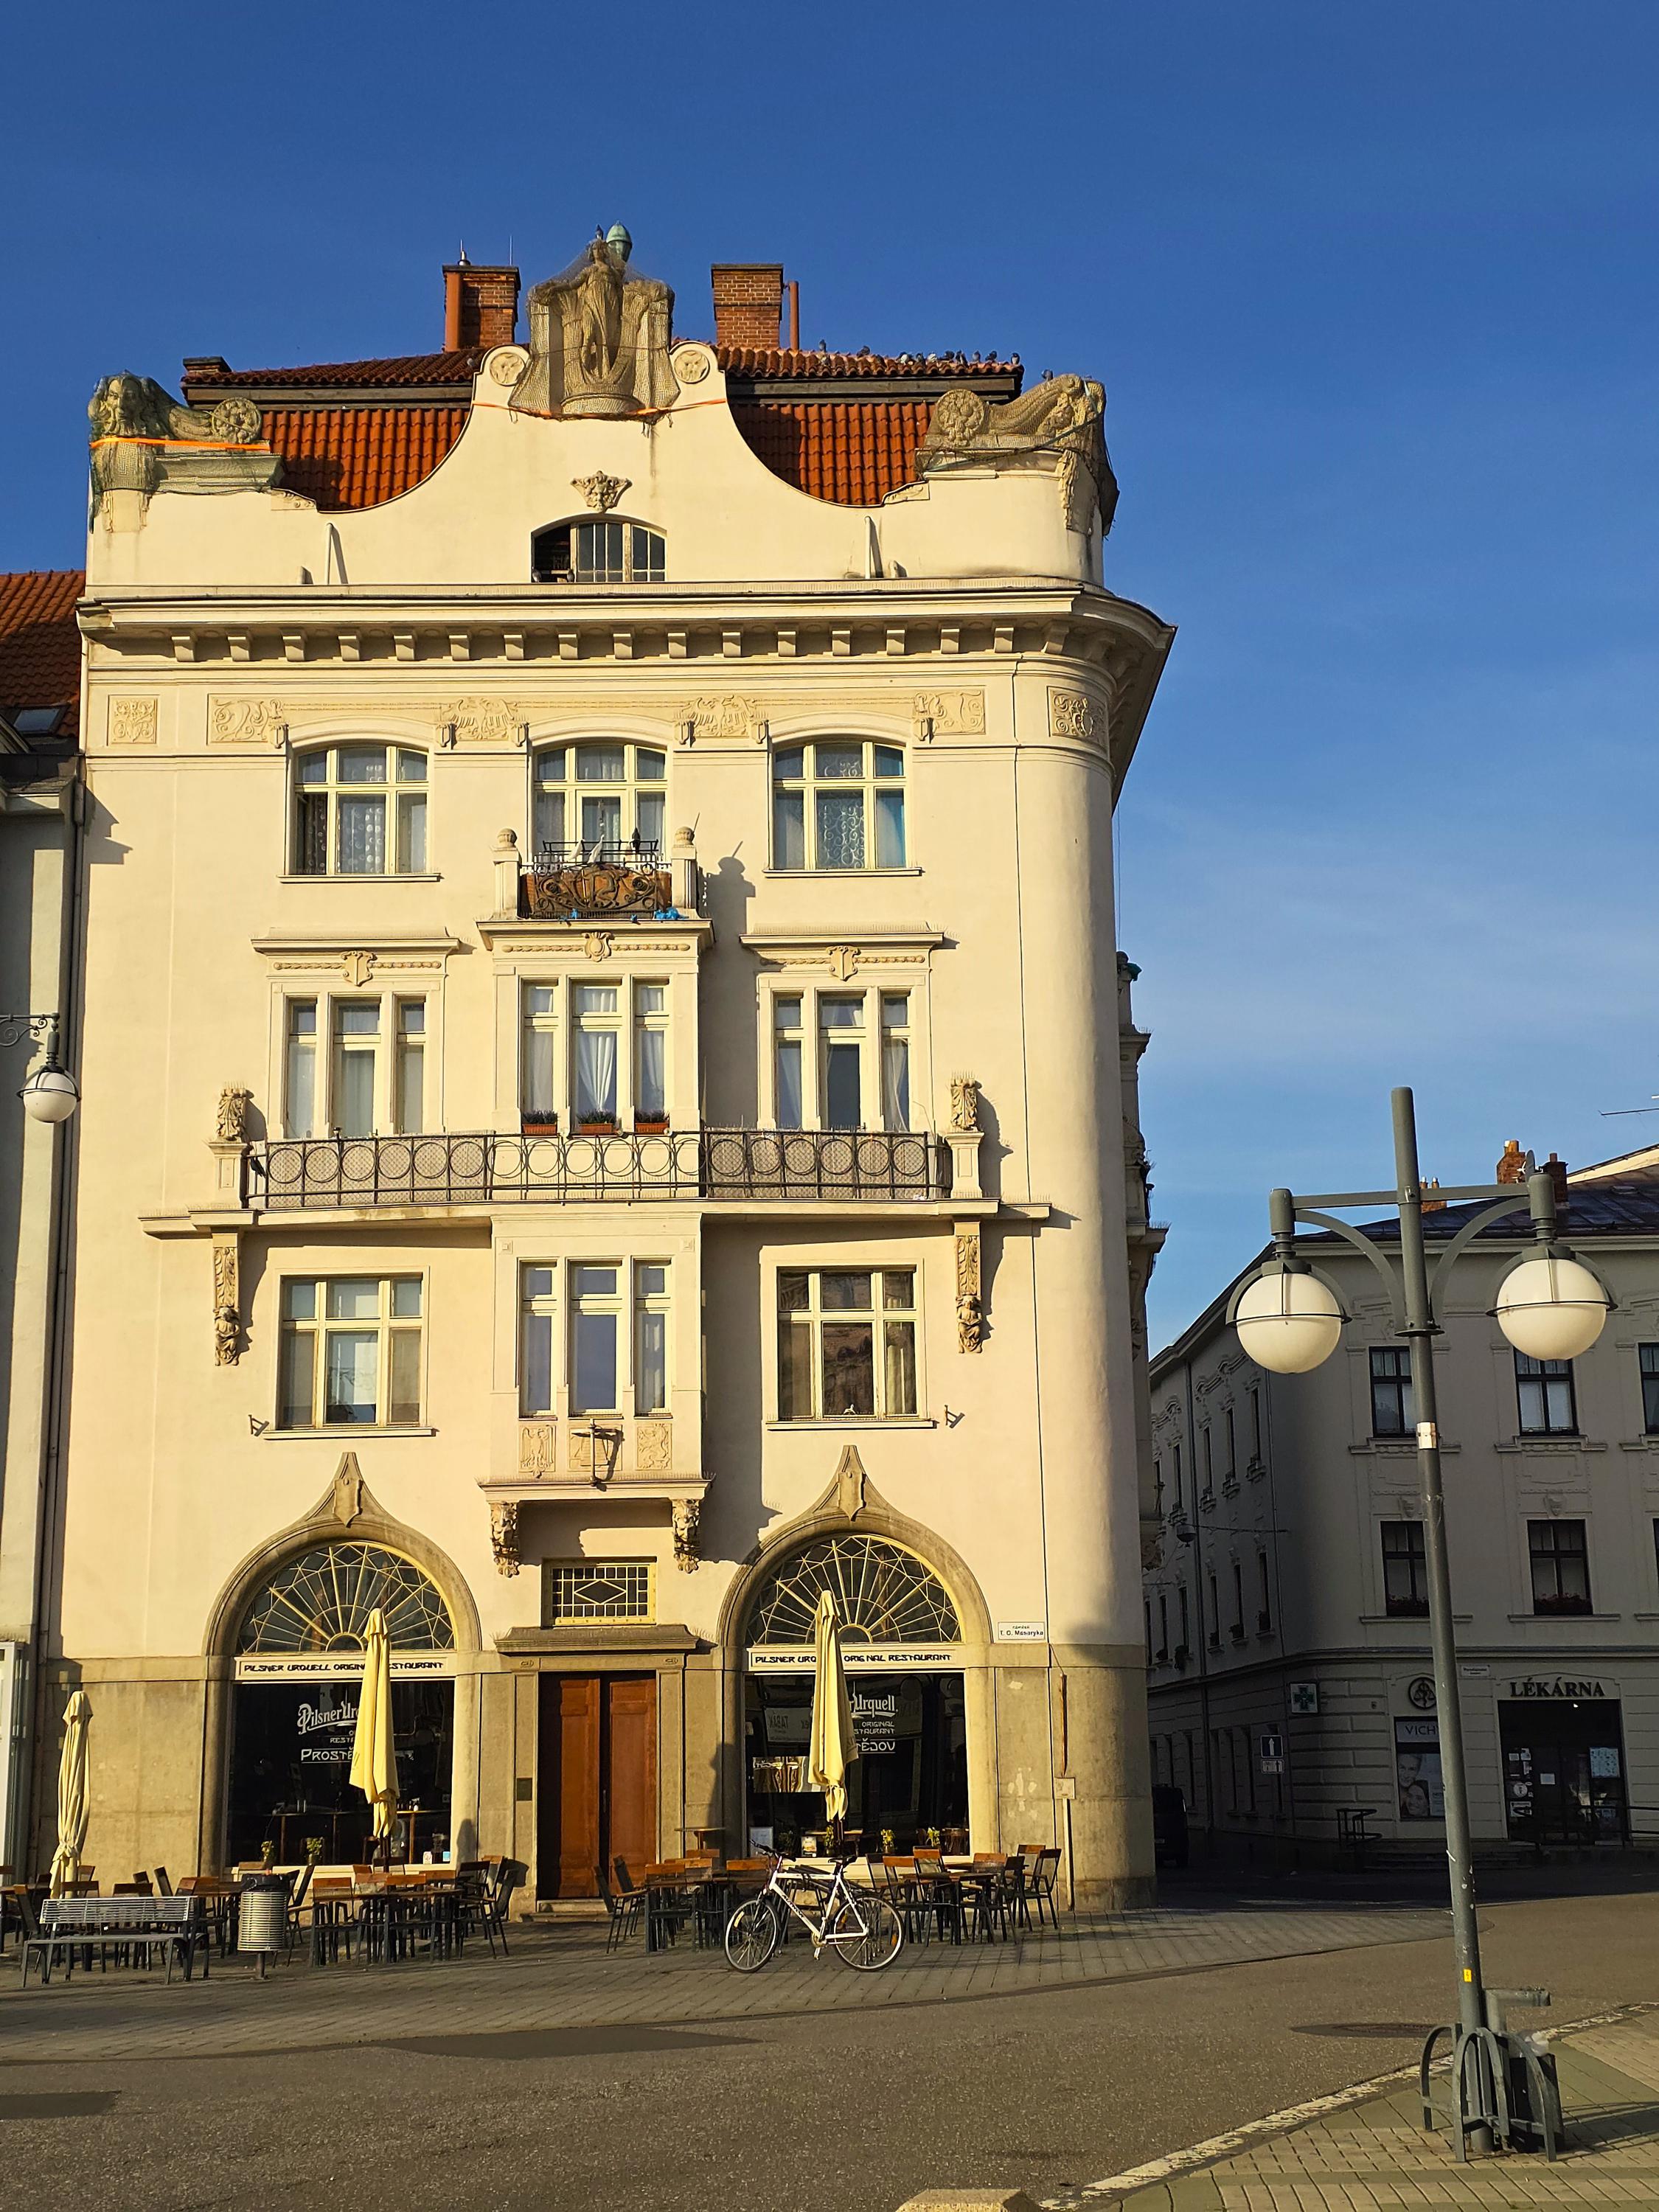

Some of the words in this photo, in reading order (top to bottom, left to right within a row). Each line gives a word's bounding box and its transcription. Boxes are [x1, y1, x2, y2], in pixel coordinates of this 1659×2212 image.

[1509, 1677, 1605, 1697] LÉKÁRNA
[296, 1703, 343, 1734] Pilsner
[1405, 1725, 1439, 1735] VICH
[856, 1738, 895, 1751] TĚJOV
[301, 1747, 354, 1761] PROSTĚ
